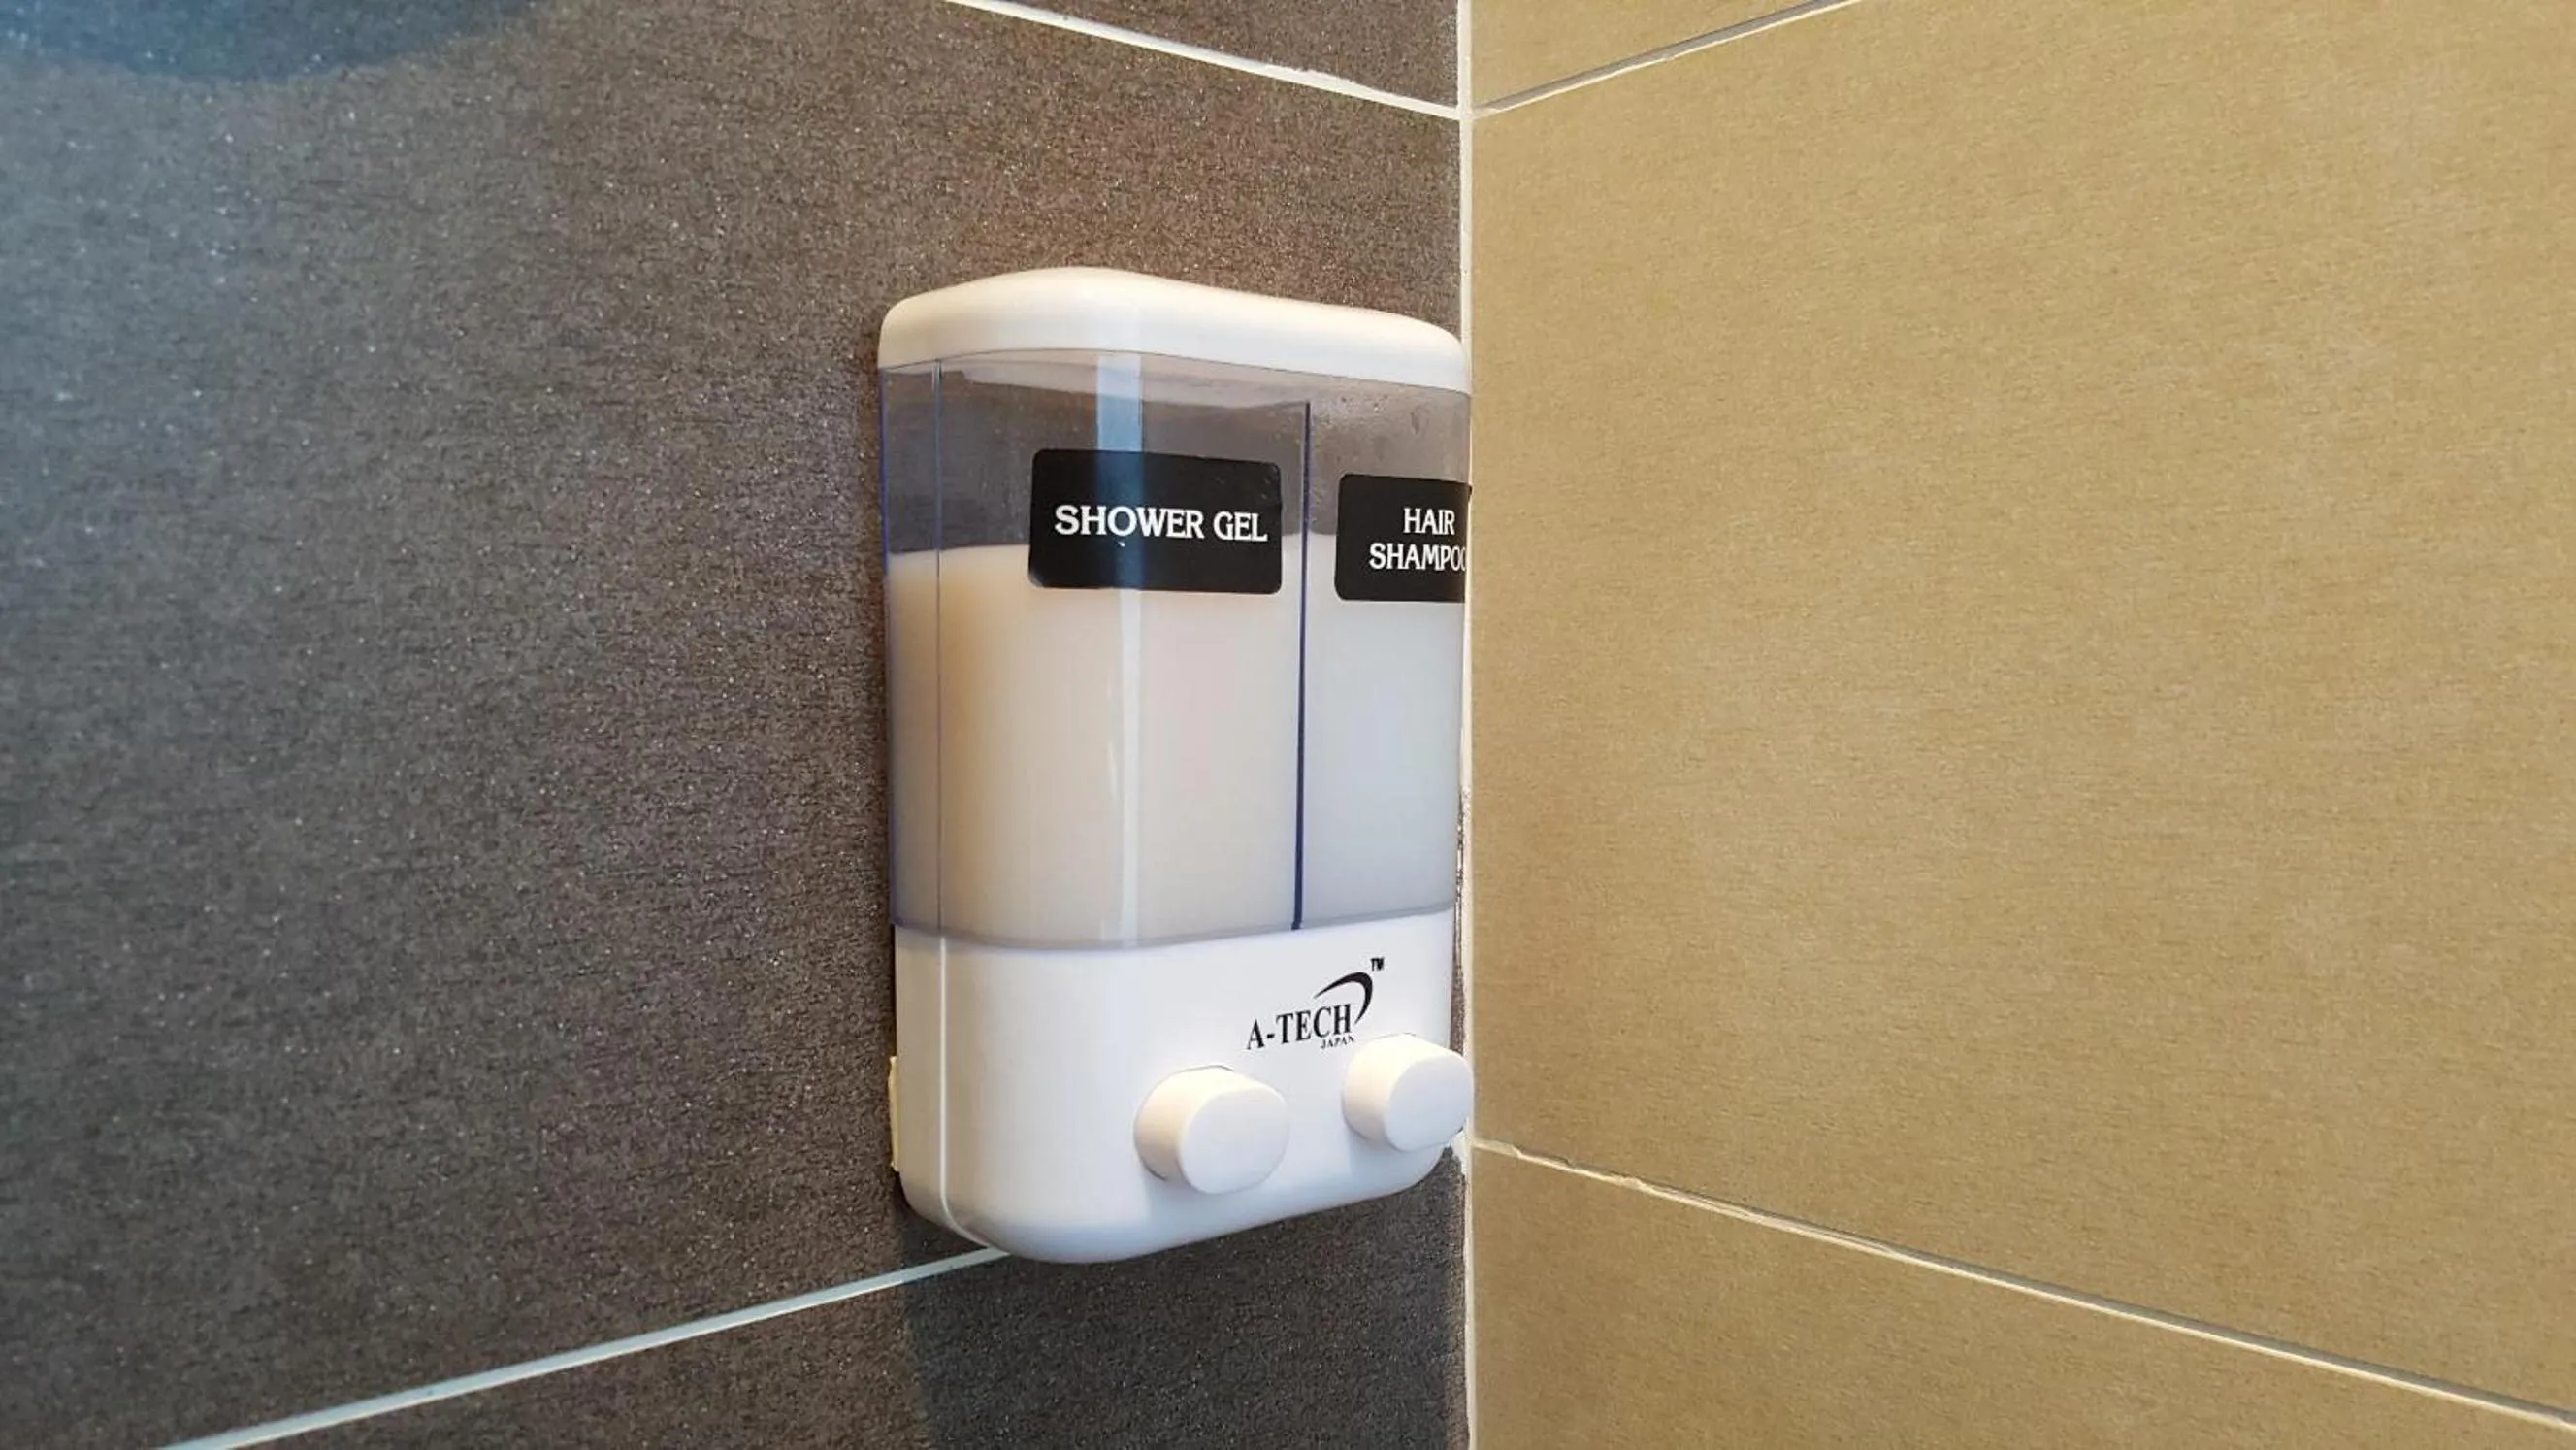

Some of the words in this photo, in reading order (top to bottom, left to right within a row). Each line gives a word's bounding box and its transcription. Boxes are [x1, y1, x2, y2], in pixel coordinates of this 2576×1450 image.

[1055, 504, 1204, 539] SHOWER
[1213, 511, 1268, 543] GEL
[1403, 507, 1455, 536] HAIR
[1247, 1003, 1352, 1050] A-TECH
[1321, 1036, 1354, 1049] JAPAN
